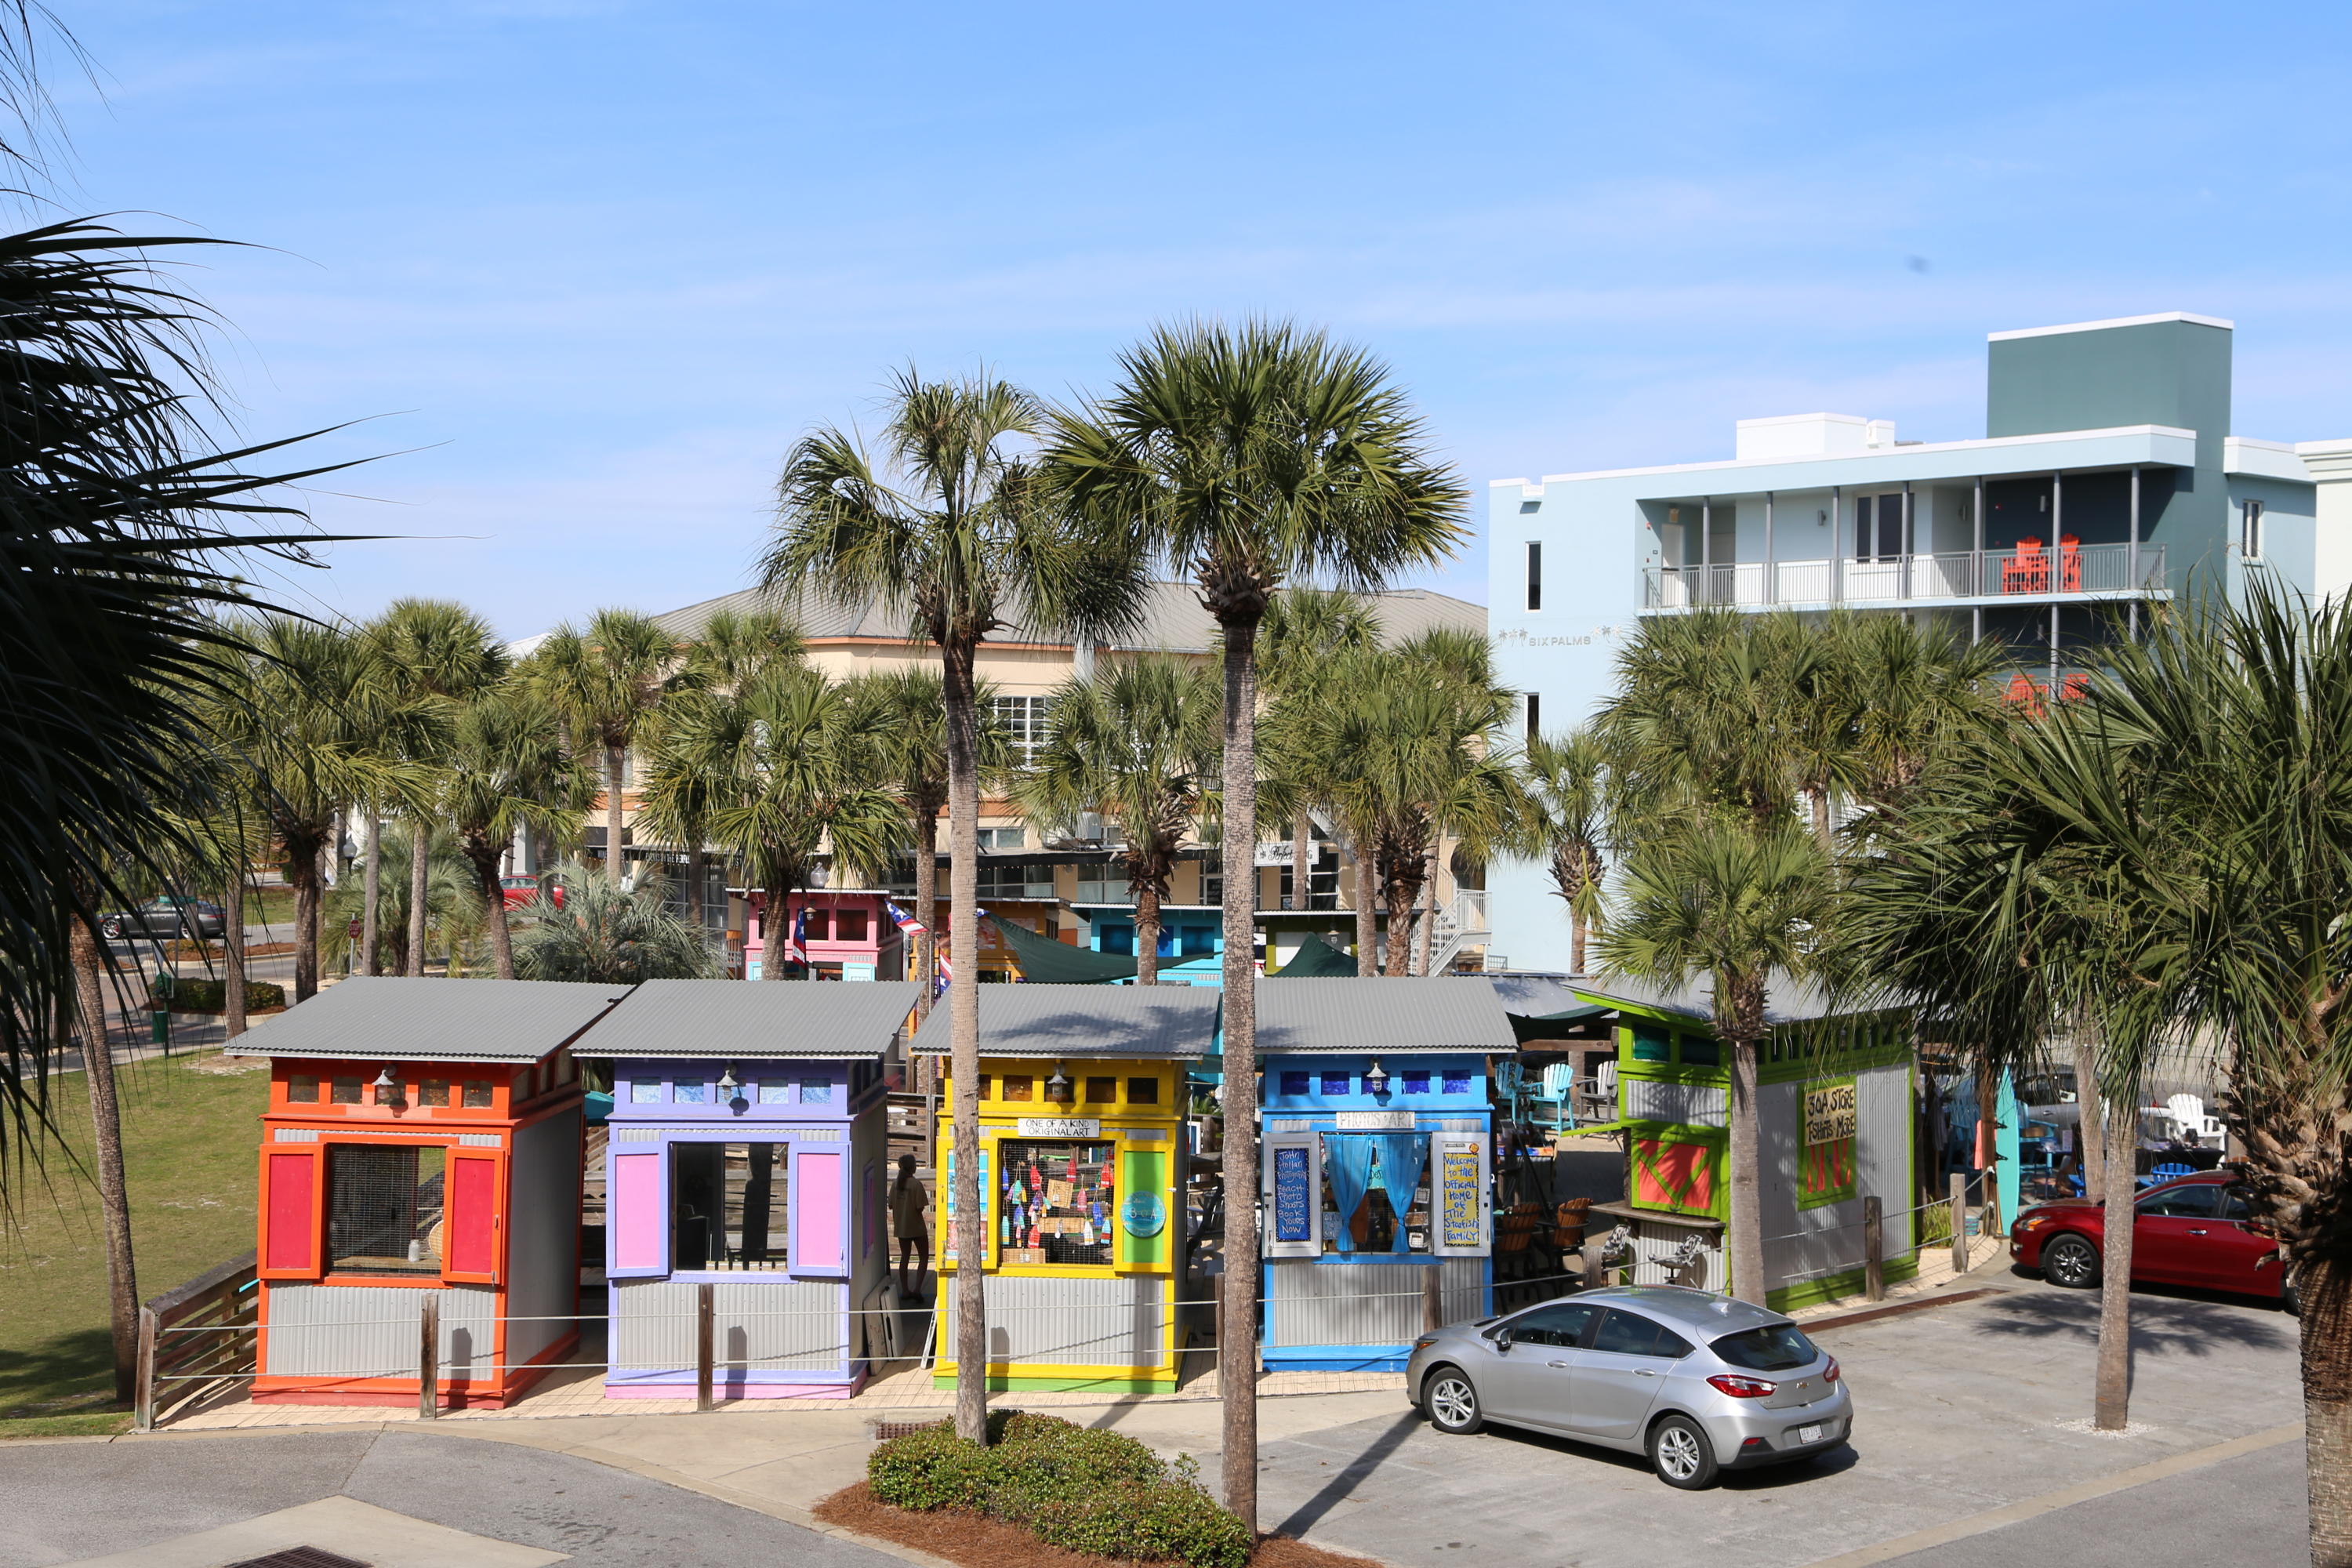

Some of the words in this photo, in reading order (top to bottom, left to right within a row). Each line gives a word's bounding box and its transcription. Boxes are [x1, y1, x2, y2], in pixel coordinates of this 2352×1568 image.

[1530, 637, 1548, 647] SIX
[1551, 636, 1592, 646] PALMS
[1807, 1091, 1830, 1117] 30A
[1831, 1087, 1854, 1112] STORE
[1025, 1119, 1043, 1127] ONE
[1046, 1119, 1057, 1128] OF
[1059, 1119, 1068, 1128] A
[1069, 1119, 1090, 1128] KIND
[1340, 1113, 1381, 1127] PHOTOS
[1388, 1112, 1413, 1127] ART
[1028, 1127, 1072, 1136] ORIGINAL
[1073, 1127, 1091, 1138] ART
